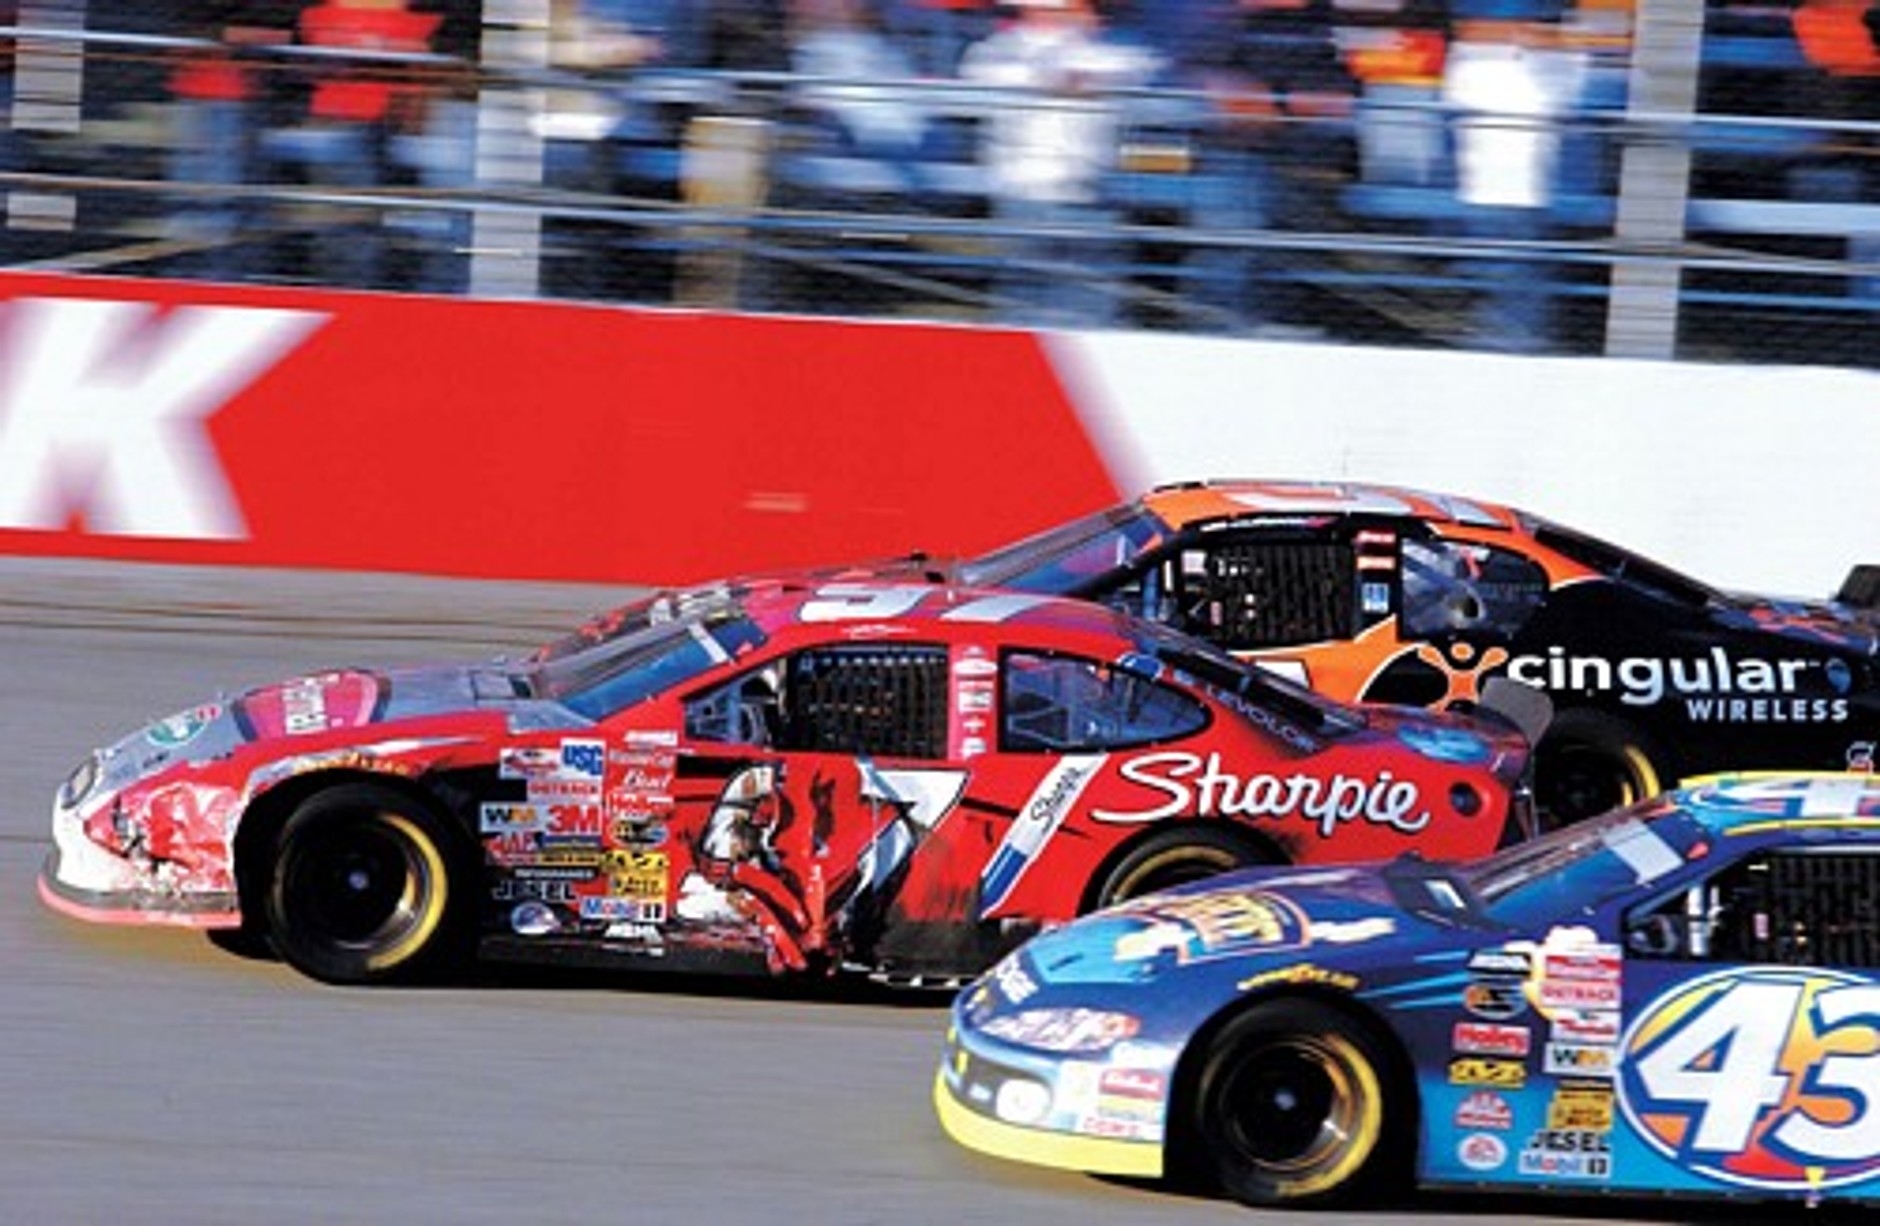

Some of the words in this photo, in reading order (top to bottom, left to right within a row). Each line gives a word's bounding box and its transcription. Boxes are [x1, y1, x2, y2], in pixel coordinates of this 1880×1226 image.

[0, 297, 335, 541] K
[1507, 646, 1806, 705] cingular
[1686, 699, 1849, 722] WIRELESS
[562, 744, 603, 776] USG
[1091, 751, 1431, 836] Sharpie
[549, 806, 601, 831] 3M
[1636, 980, 1880, 1160] 43
[1531, 1132, 1610, 1151] JESEL
